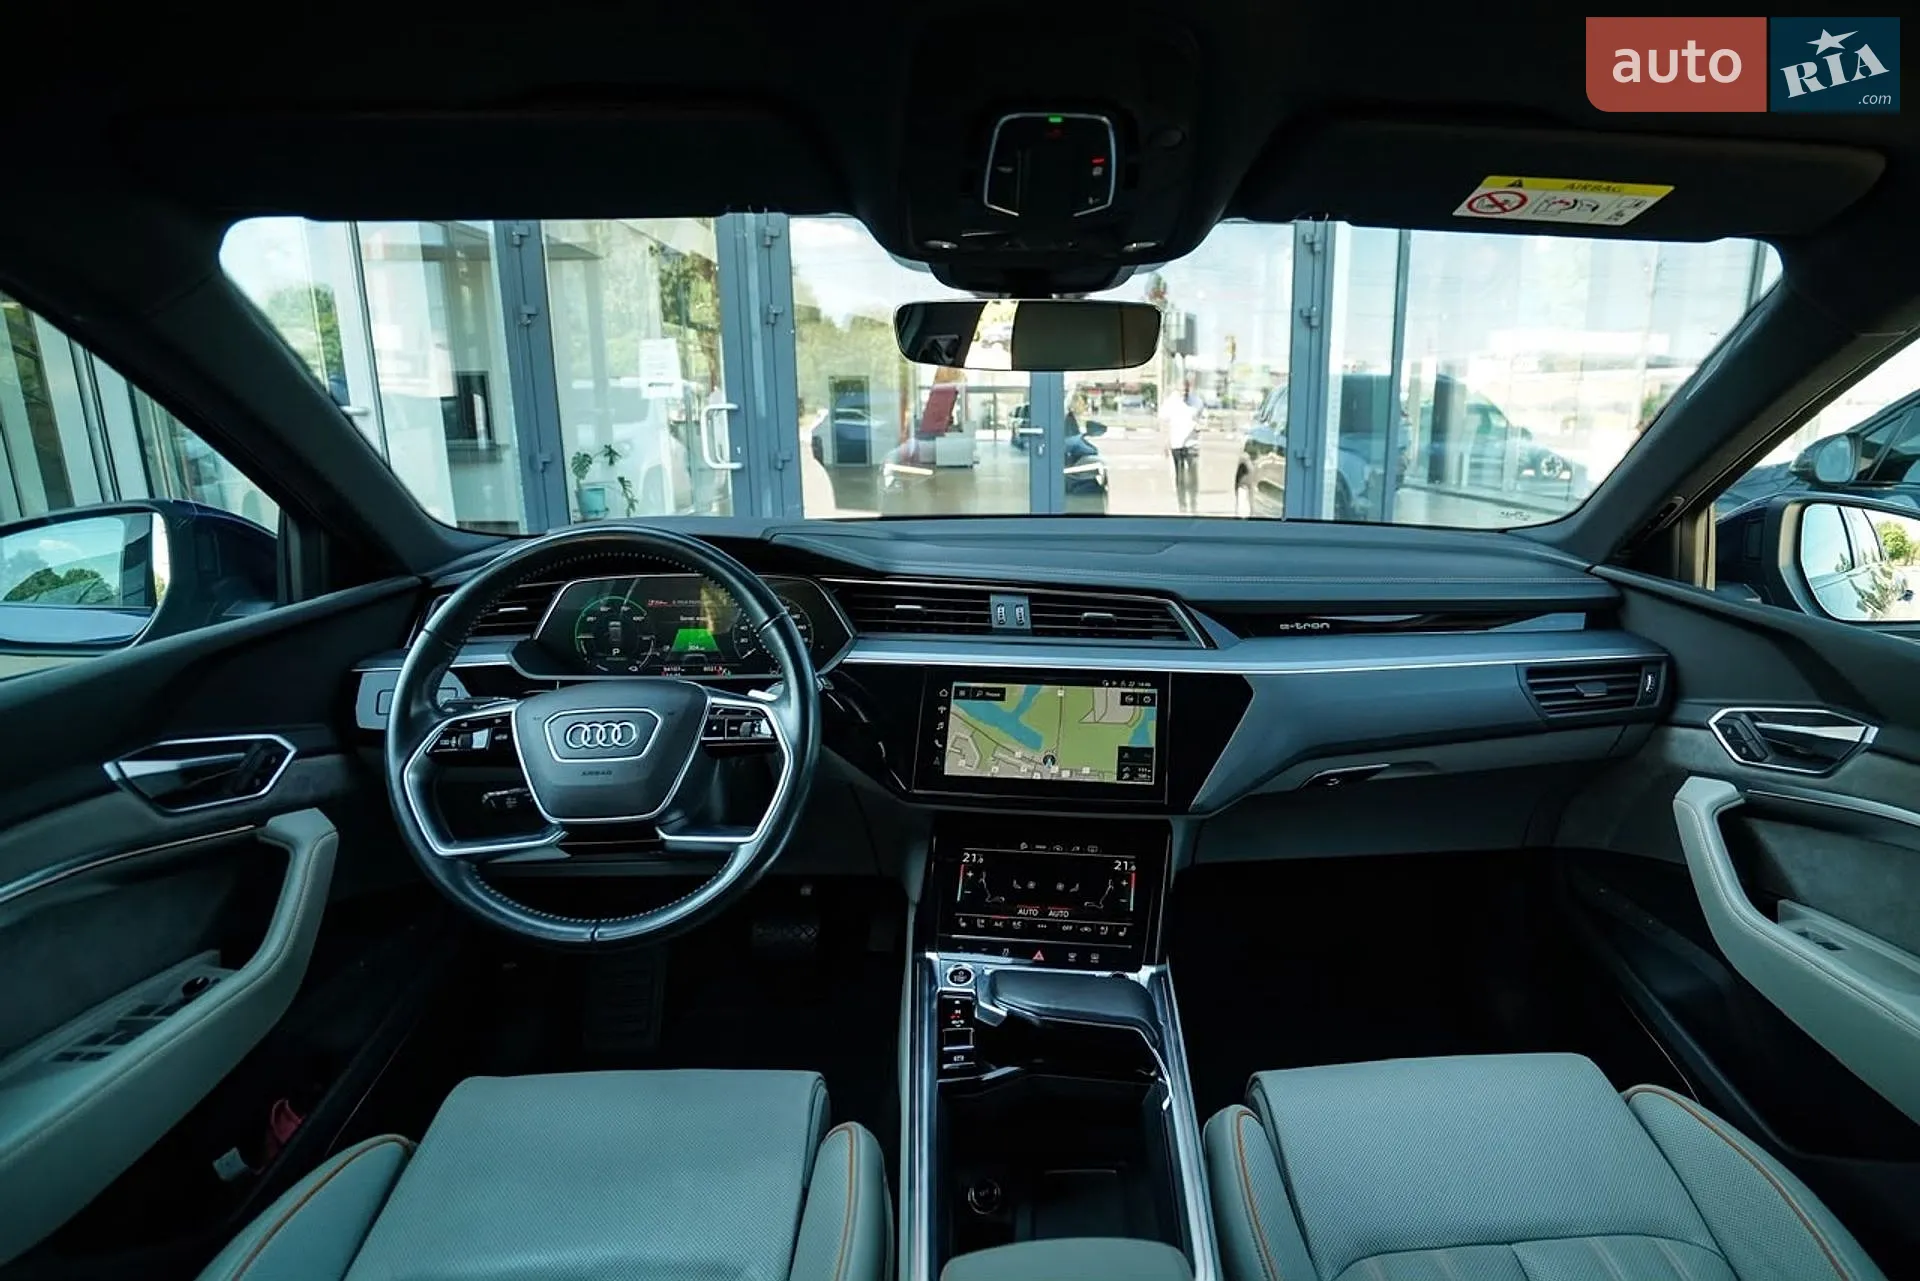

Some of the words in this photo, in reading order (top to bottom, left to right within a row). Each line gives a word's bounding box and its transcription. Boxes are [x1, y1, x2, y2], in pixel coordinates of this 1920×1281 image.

[1279, 622, 1331, 630] e-tron
[1017, 908, 1039, 917] AUTO
[1048, 910, 1070, 918] AUTO
